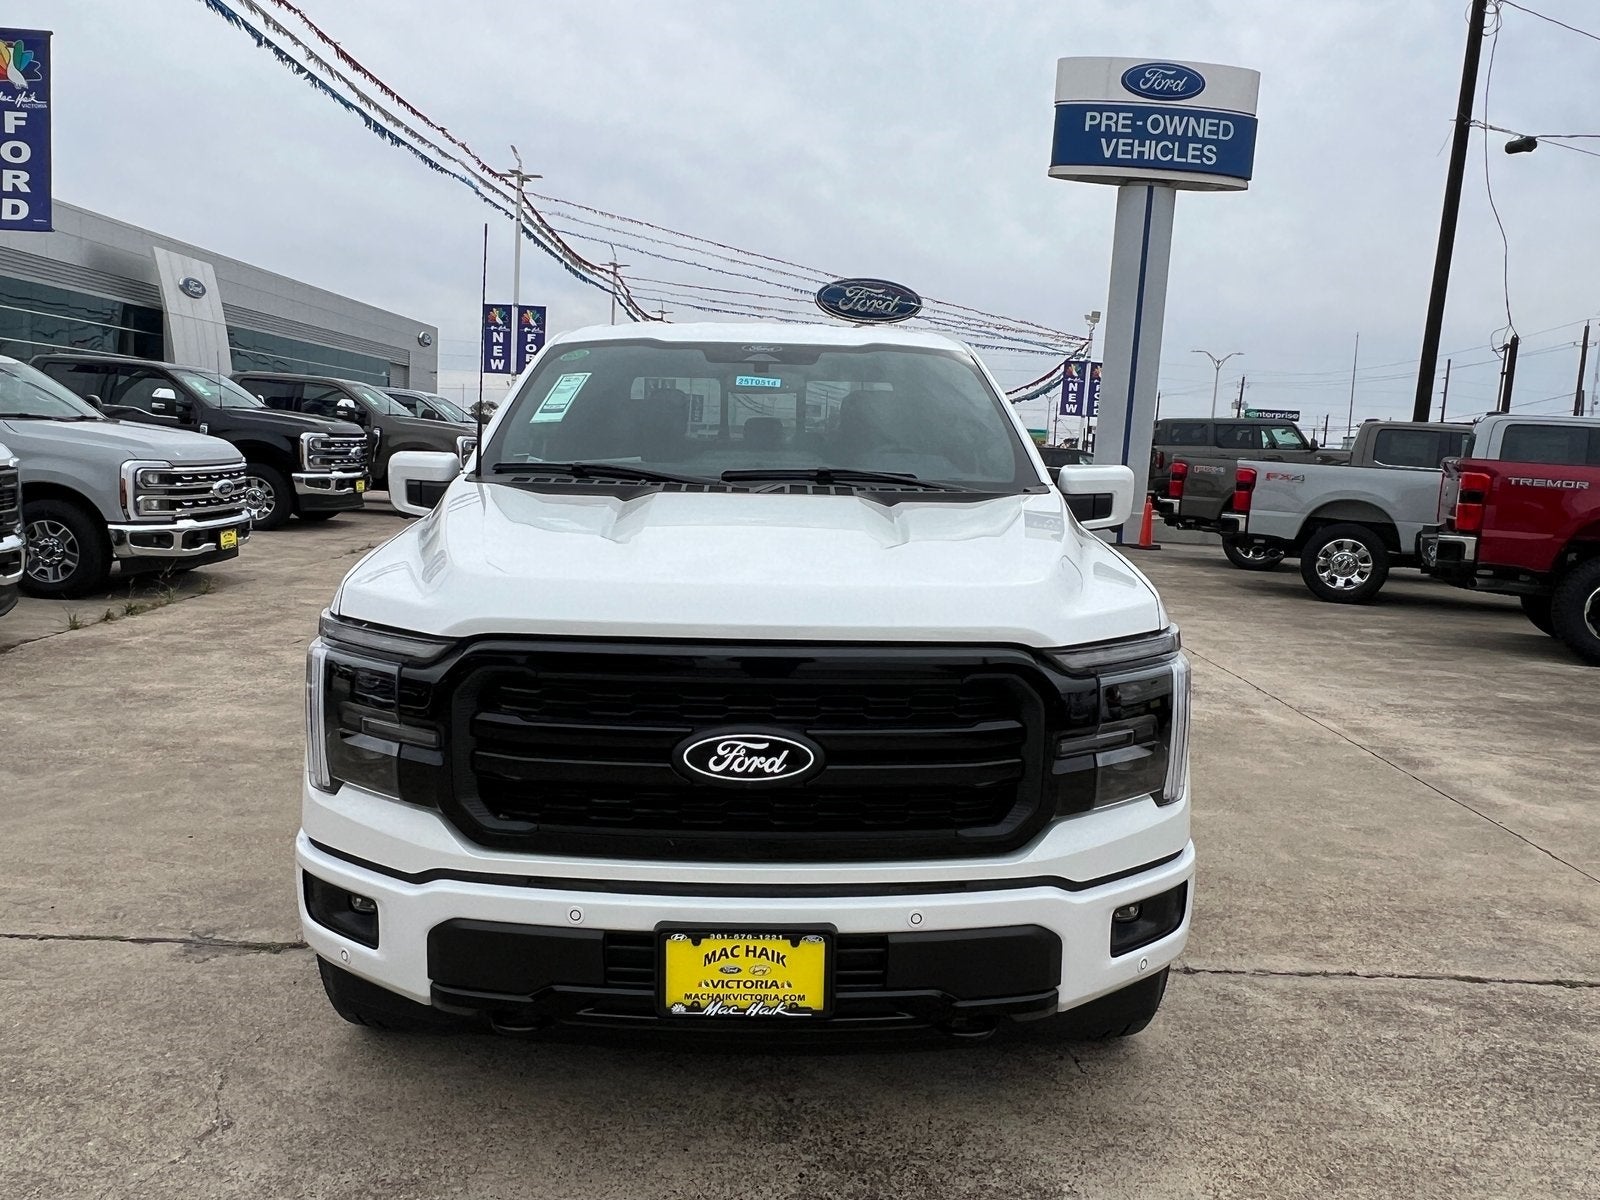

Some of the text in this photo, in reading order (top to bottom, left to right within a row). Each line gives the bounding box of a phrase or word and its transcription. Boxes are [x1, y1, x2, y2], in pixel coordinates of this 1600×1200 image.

[1139, 68, 1188, 92] Ford
[1085, 111, 1235, 141] PRE-OWNED
[1101, 138, 1218, 165] VEHICLES
[0, 111, 31, 220] FORD
[839, 285, 900, 313] Ford
[490, 331, 505, 370] NEW
[525, 333, 537, 366] FOR
[1065, 382, 1079, 413] NEW
[1266, 472, 1305, 482] FX4
[1508, 477, 1590, 490] TREMOR
[708, 740, 789, 773] Ford
[703, 944, 787, 968] MAC HAIK
[709, 979, 780, 989] VICTORIA
[701, 1001, 802, 1016] Mac Haik
